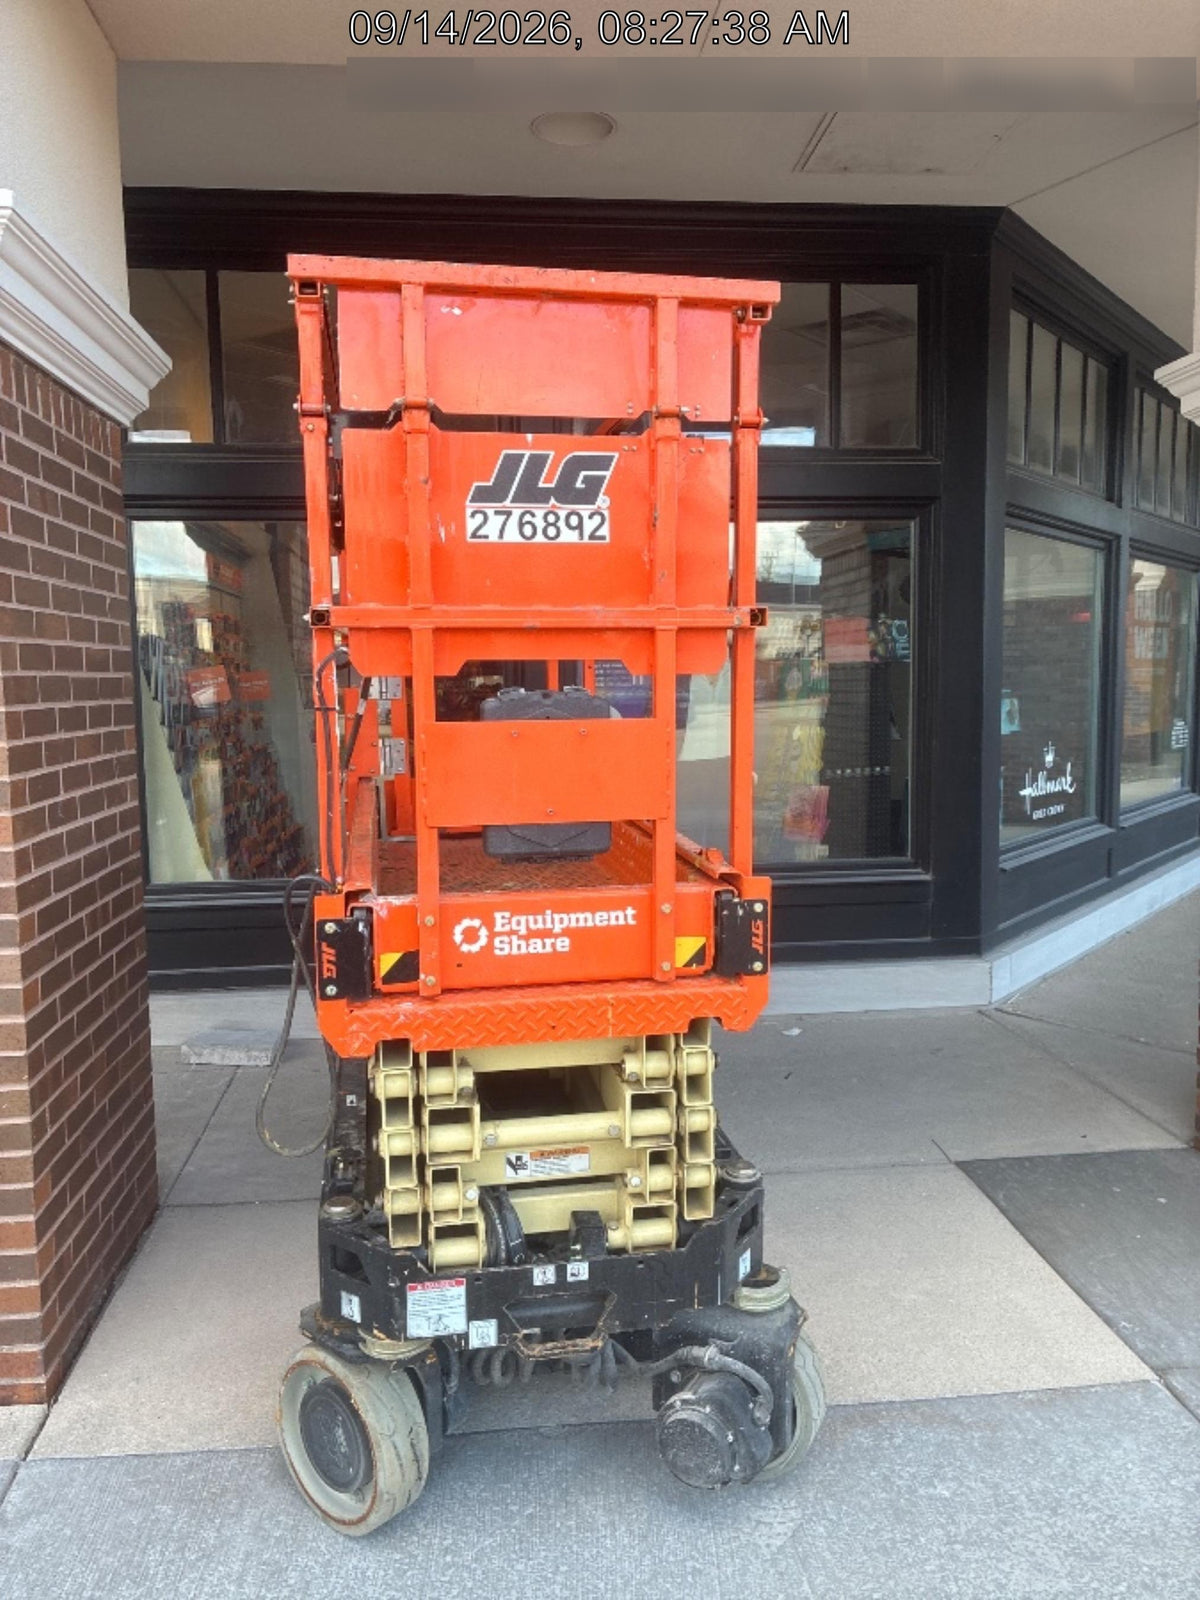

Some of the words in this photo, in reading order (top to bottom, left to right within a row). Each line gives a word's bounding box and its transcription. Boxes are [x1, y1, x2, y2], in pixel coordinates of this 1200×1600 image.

[466, 450, 619, 508] JLG
[468, 509, 607, 541] 276892
[1019, 761, 1077, 815] Hallmark
[493, 906, 637, 935] Equipment
[751, 918, 764, 955] JLG
[321, 941, 337, 979] JLG
[493, 935, 570, 955] Share
